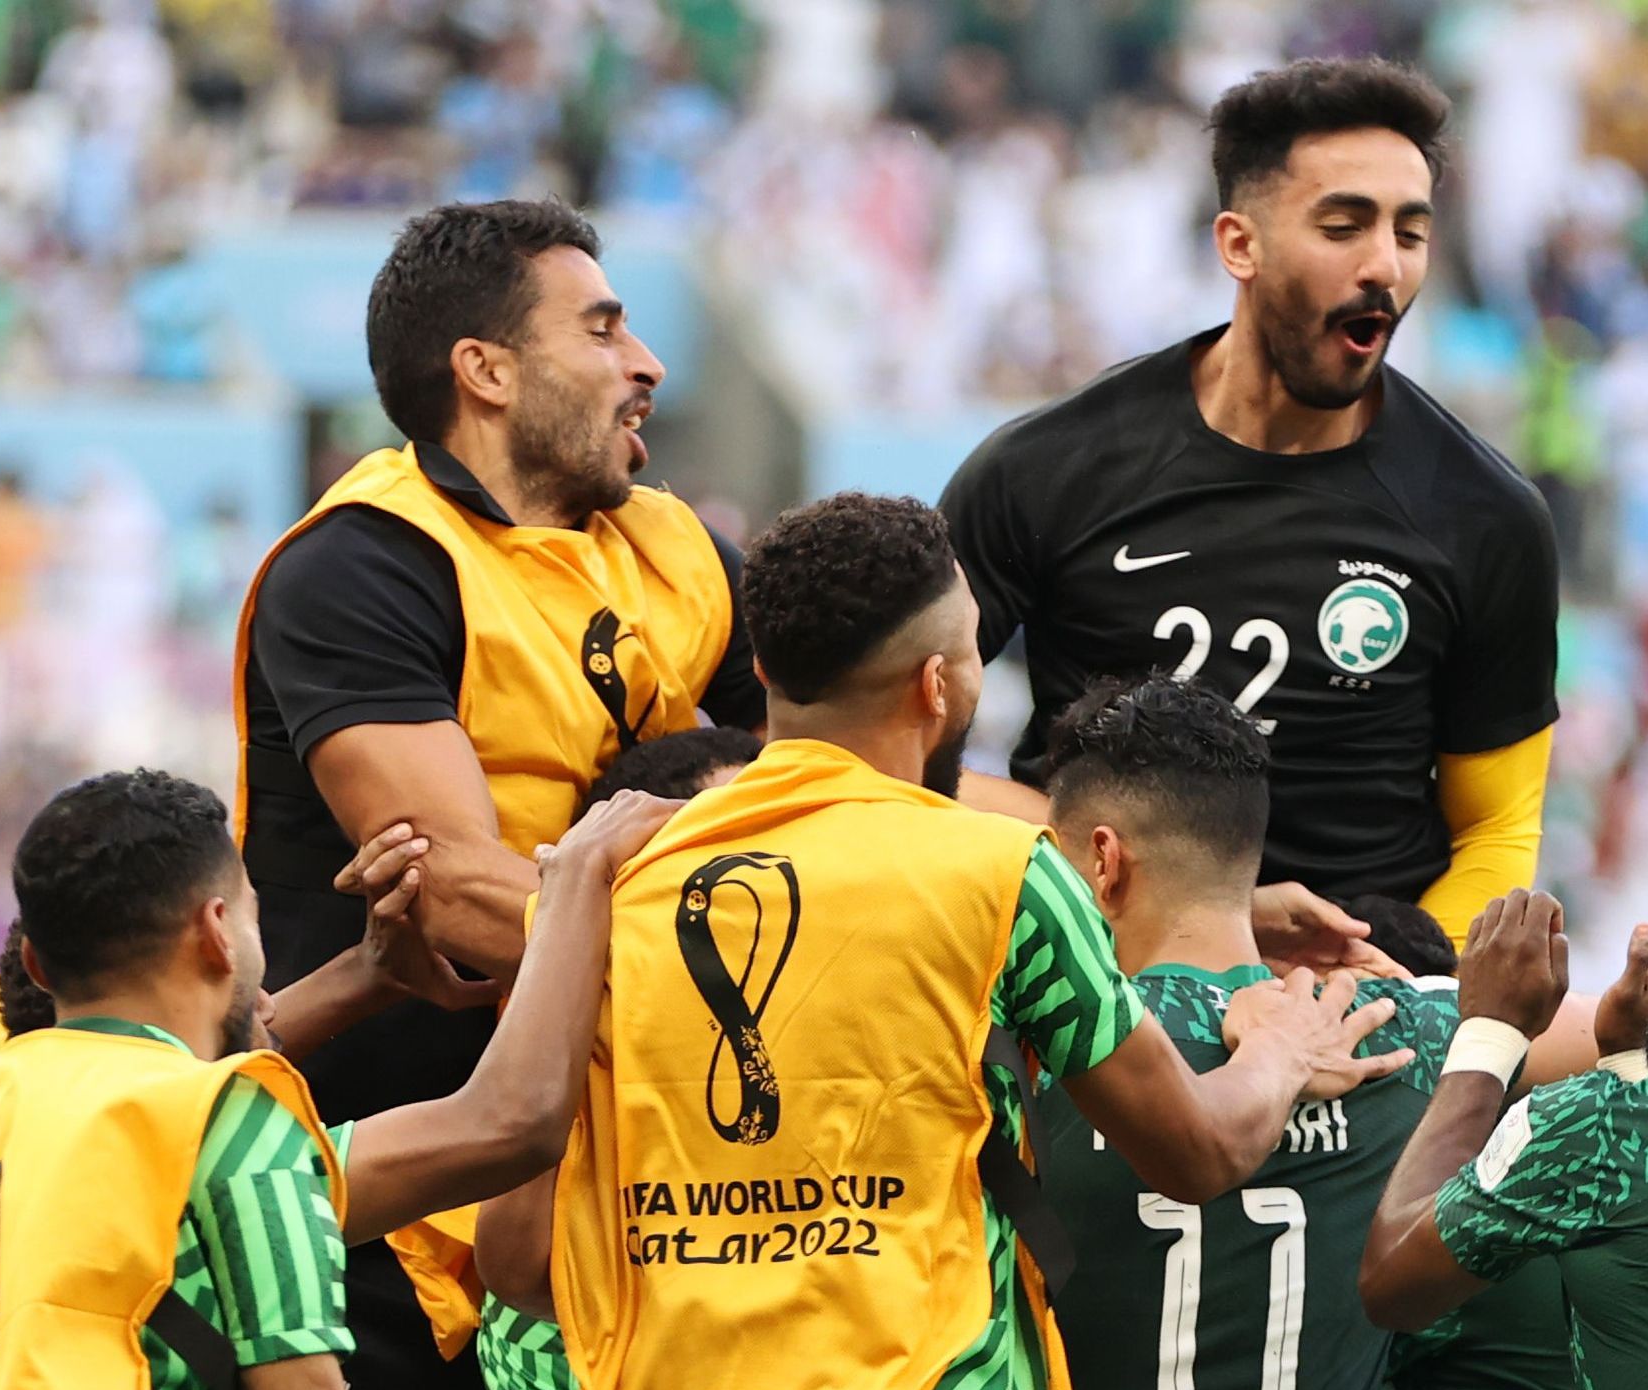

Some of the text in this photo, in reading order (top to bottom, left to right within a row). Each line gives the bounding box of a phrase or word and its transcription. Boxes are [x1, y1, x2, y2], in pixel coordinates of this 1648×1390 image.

[1153, 605, 1290, 737] 22
[685, 1177, 824, 1217] WORLD
[832, 1174, 905, 1210] CUP
